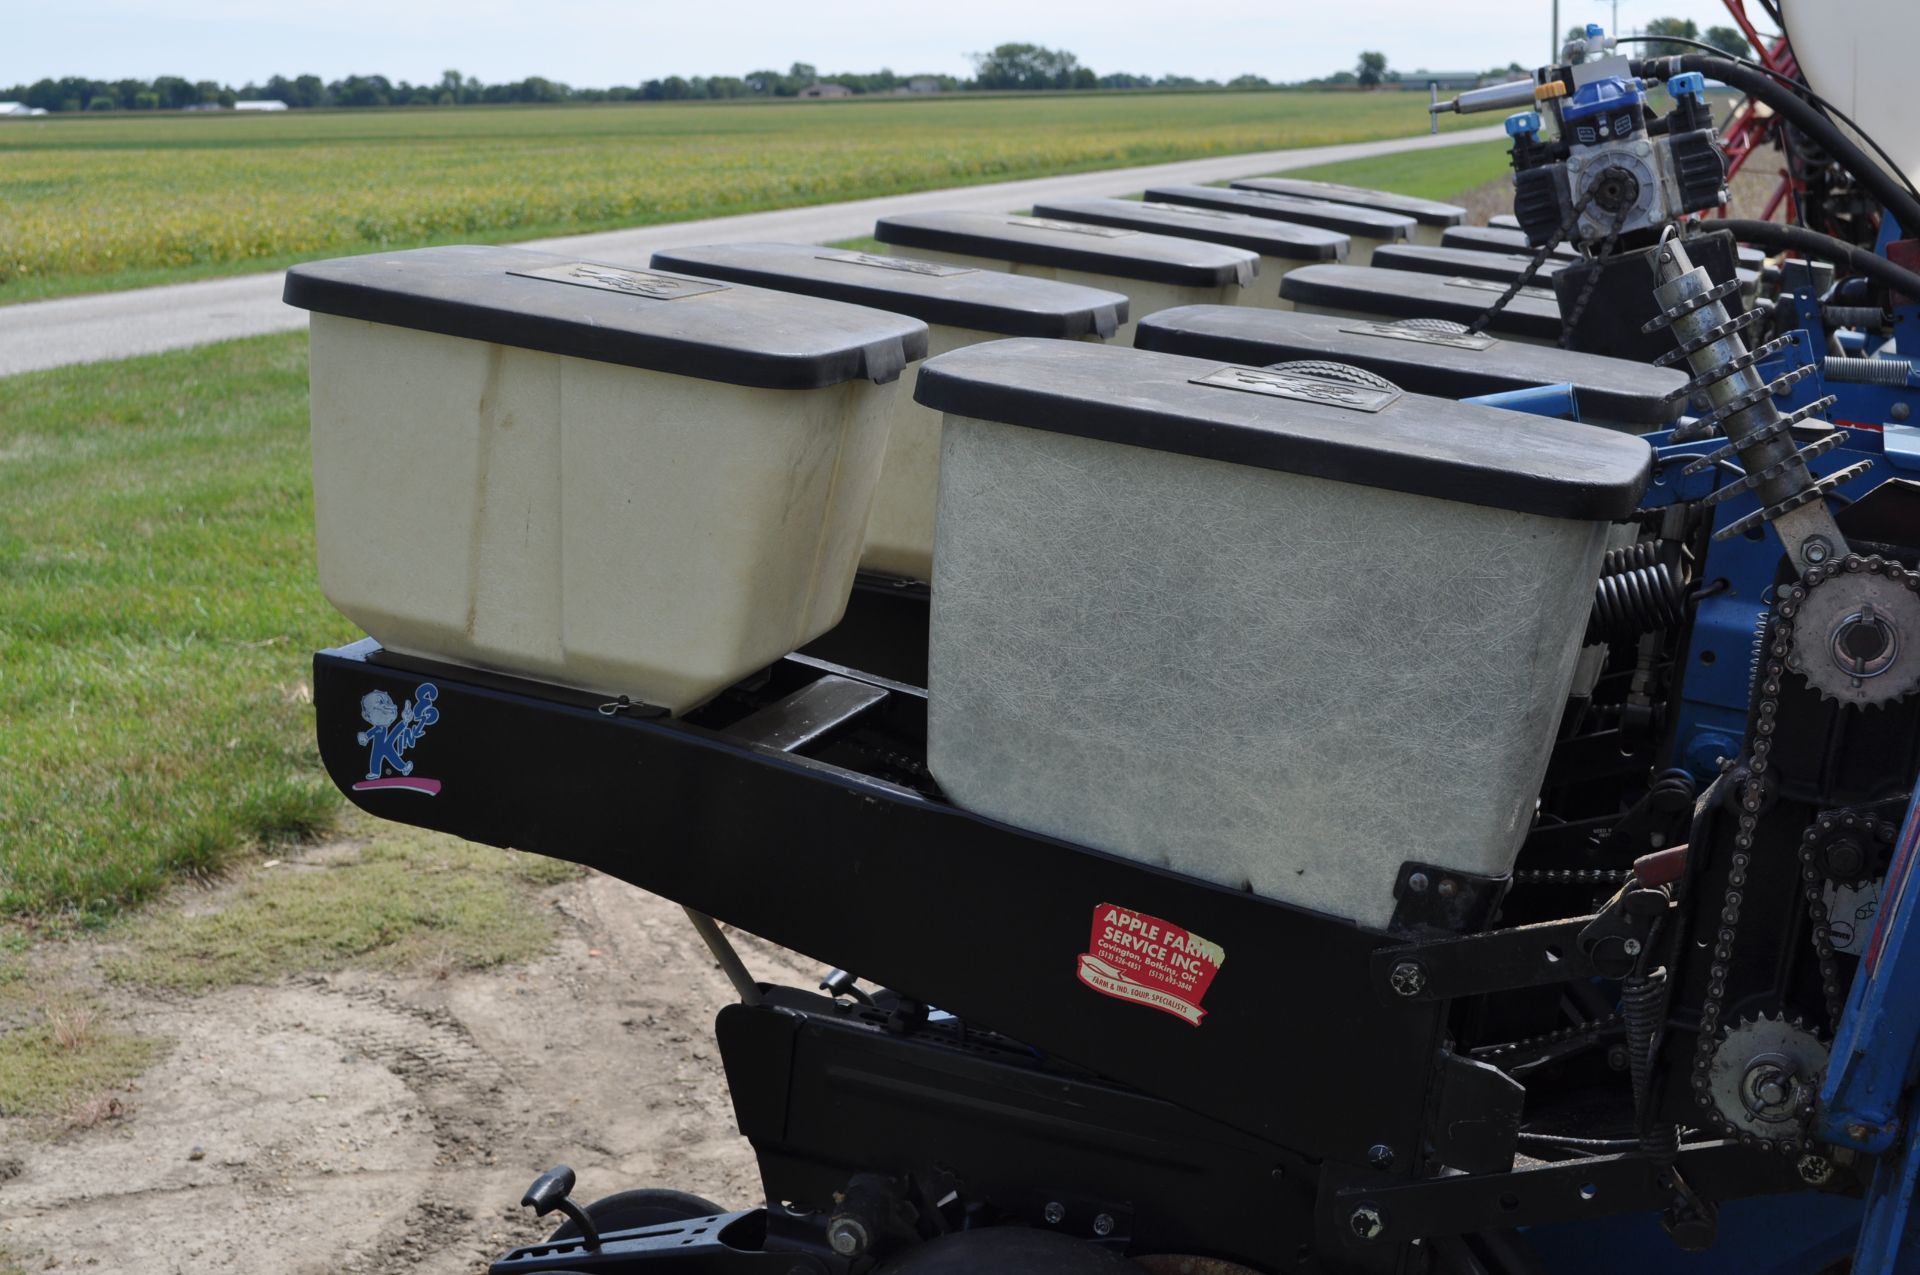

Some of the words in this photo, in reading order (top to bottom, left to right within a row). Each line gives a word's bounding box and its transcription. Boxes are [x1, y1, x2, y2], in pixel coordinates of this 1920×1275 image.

[1103, 926, 1167, 961] SERVICE
[1171, 952, 1204, 977] INC.
[1104, 909, 1160, 941] APPLE
[1164, 931, 1216, 963] FARM
[1098, 938, 1142, 963] Covington,
[1145, 957, 1178, 977] Botkins,
[1181, 971, 1198, 984] OH.
[1098, 949, 1114, 962] (513)
[1148, 969, 1164, 982] (513)
[1092, 976, 1109, 990] FARM
[1109, 983, 1115, 991] &
[1116, 984, 1129, 995] IND.
[1131, 988, 1150, 1000] EQUIP.
[1152, 993, 1188, 1014] SPECIALISTS
